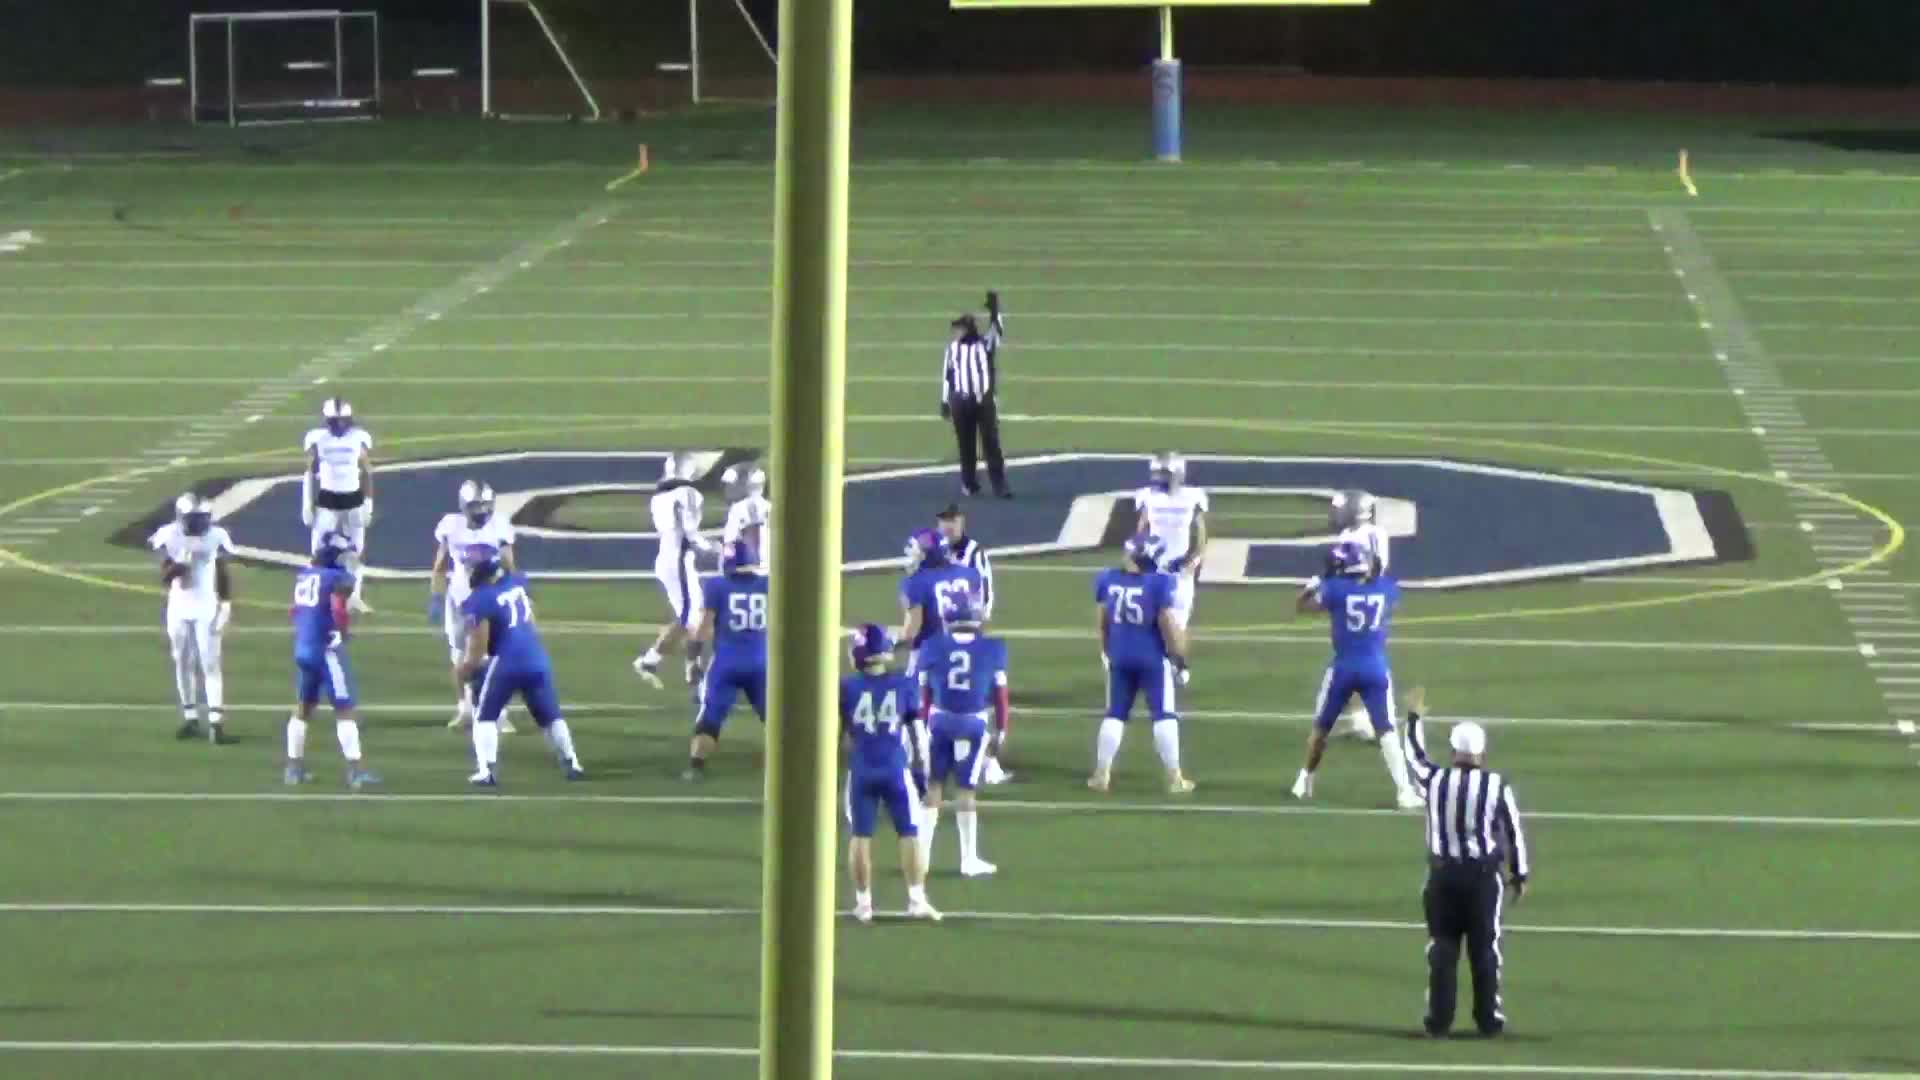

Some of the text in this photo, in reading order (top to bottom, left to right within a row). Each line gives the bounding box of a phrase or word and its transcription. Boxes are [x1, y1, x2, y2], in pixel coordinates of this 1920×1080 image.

[728, 593, 767, 631] 58
[1108, 584, 1144, 625] 75
[1346, 594, 1385, 632] 57
[947, 650, 971, 690] 2
[853, 689, 899, 735] 44
